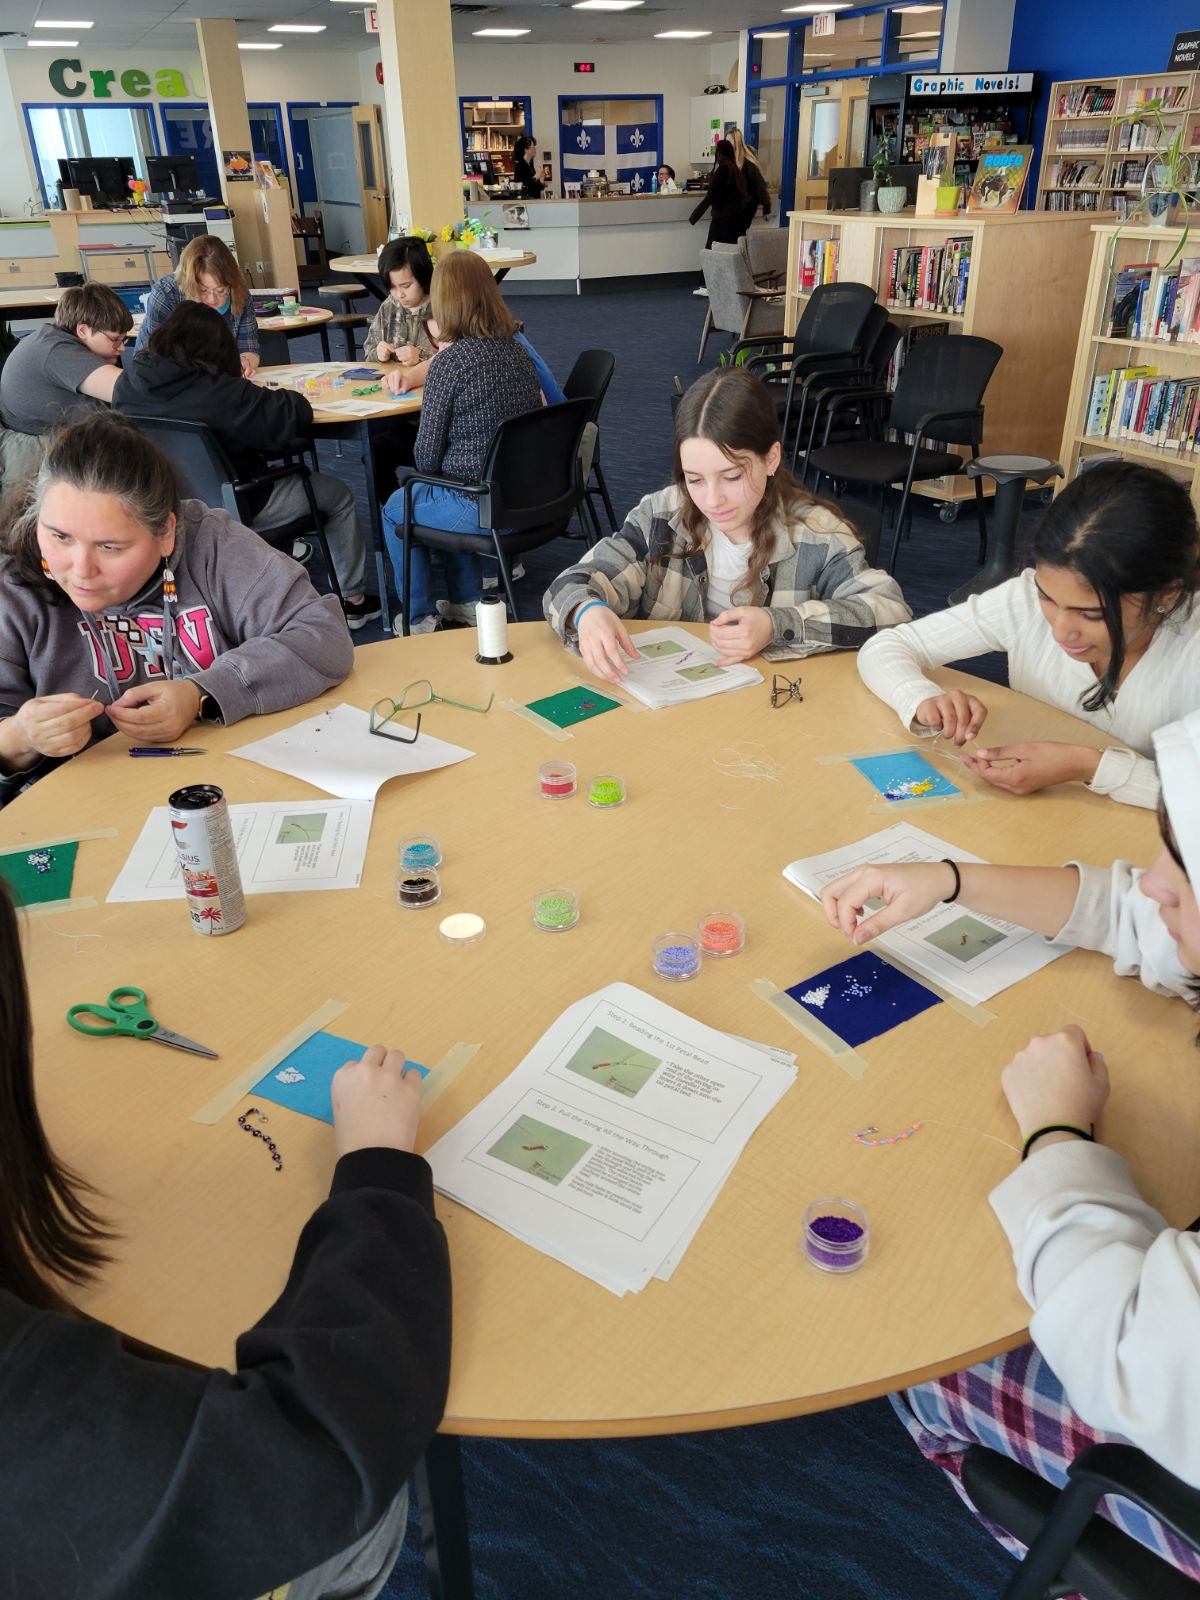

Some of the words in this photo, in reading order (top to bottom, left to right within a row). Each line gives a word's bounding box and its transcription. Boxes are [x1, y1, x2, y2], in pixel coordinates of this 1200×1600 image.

[815, 16, 829, 34] EXIT
[1174, 53, 1195, 62] NOVELS
[913, 78, 964, 95] Graphic
[975, 75, 1019, 91] Novels!
